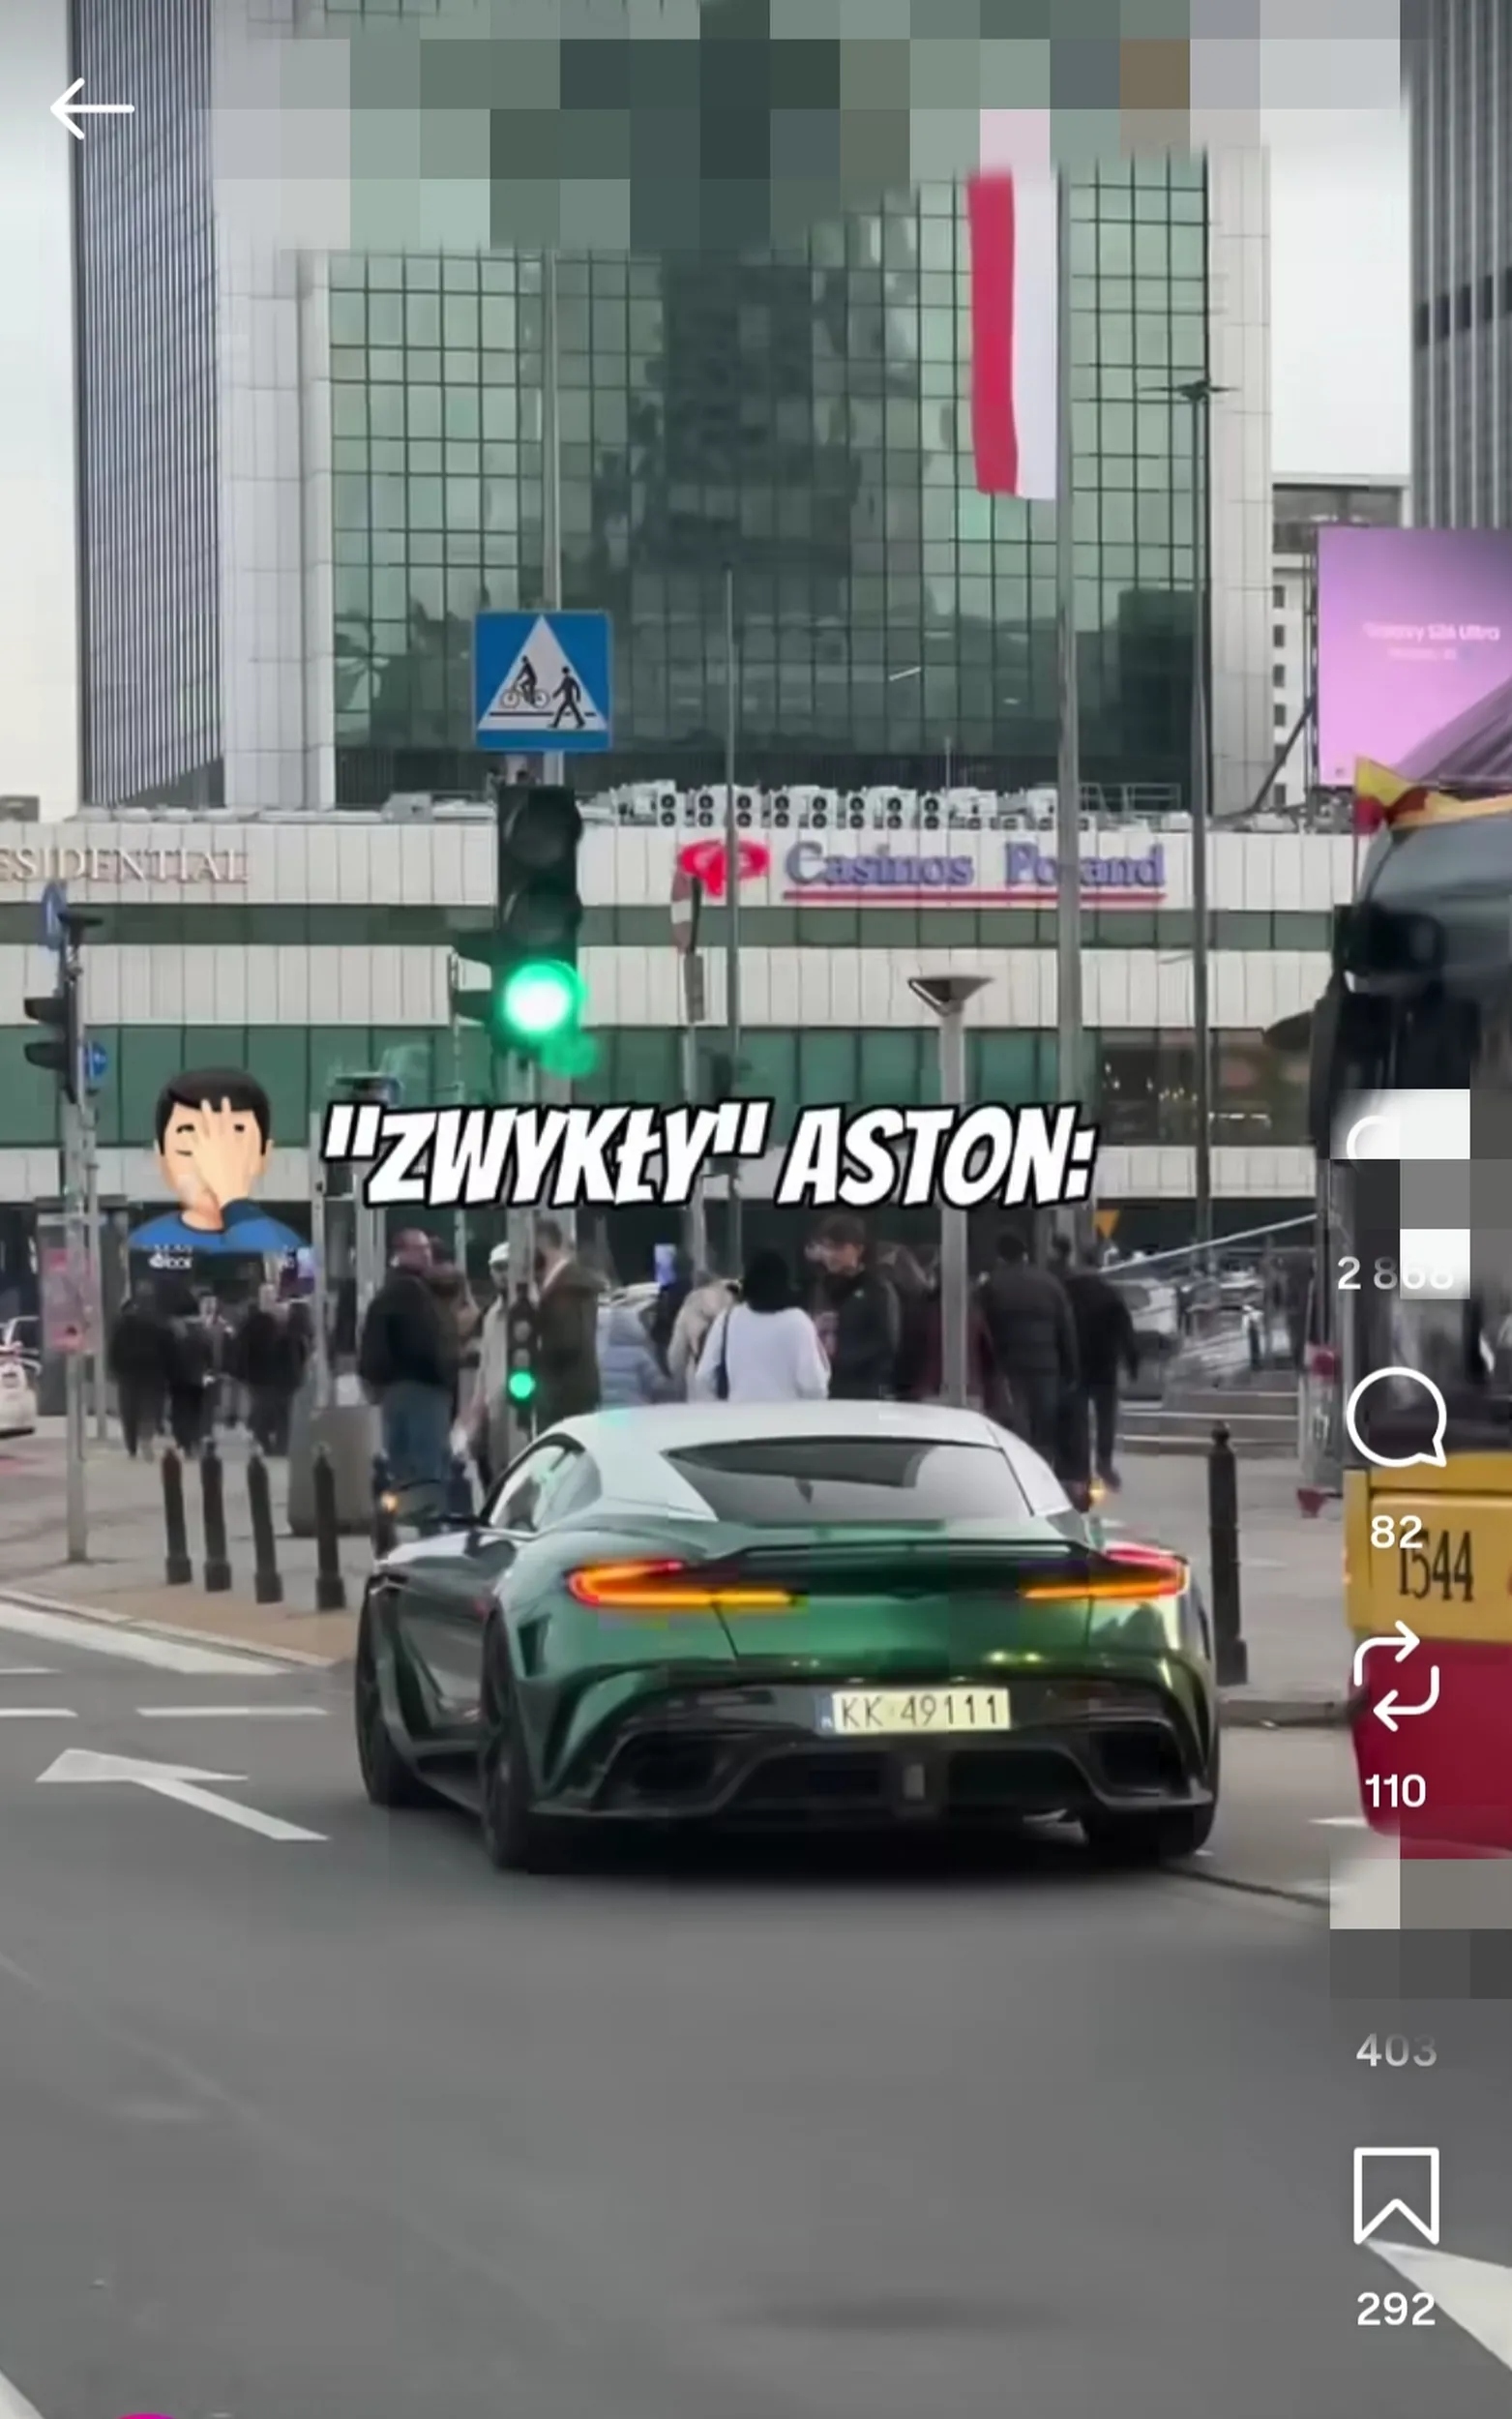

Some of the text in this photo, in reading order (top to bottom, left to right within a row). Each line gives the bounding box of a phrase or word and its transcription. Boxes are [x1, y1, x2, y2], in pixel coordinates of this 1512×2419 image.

[786, 839, 975, 886] Casinos
[1005, 841, 1167, 887] Poand
[1399, 1529, 1474, 1602] 1544
[841, 1693, 997, 1728] KK 49111
